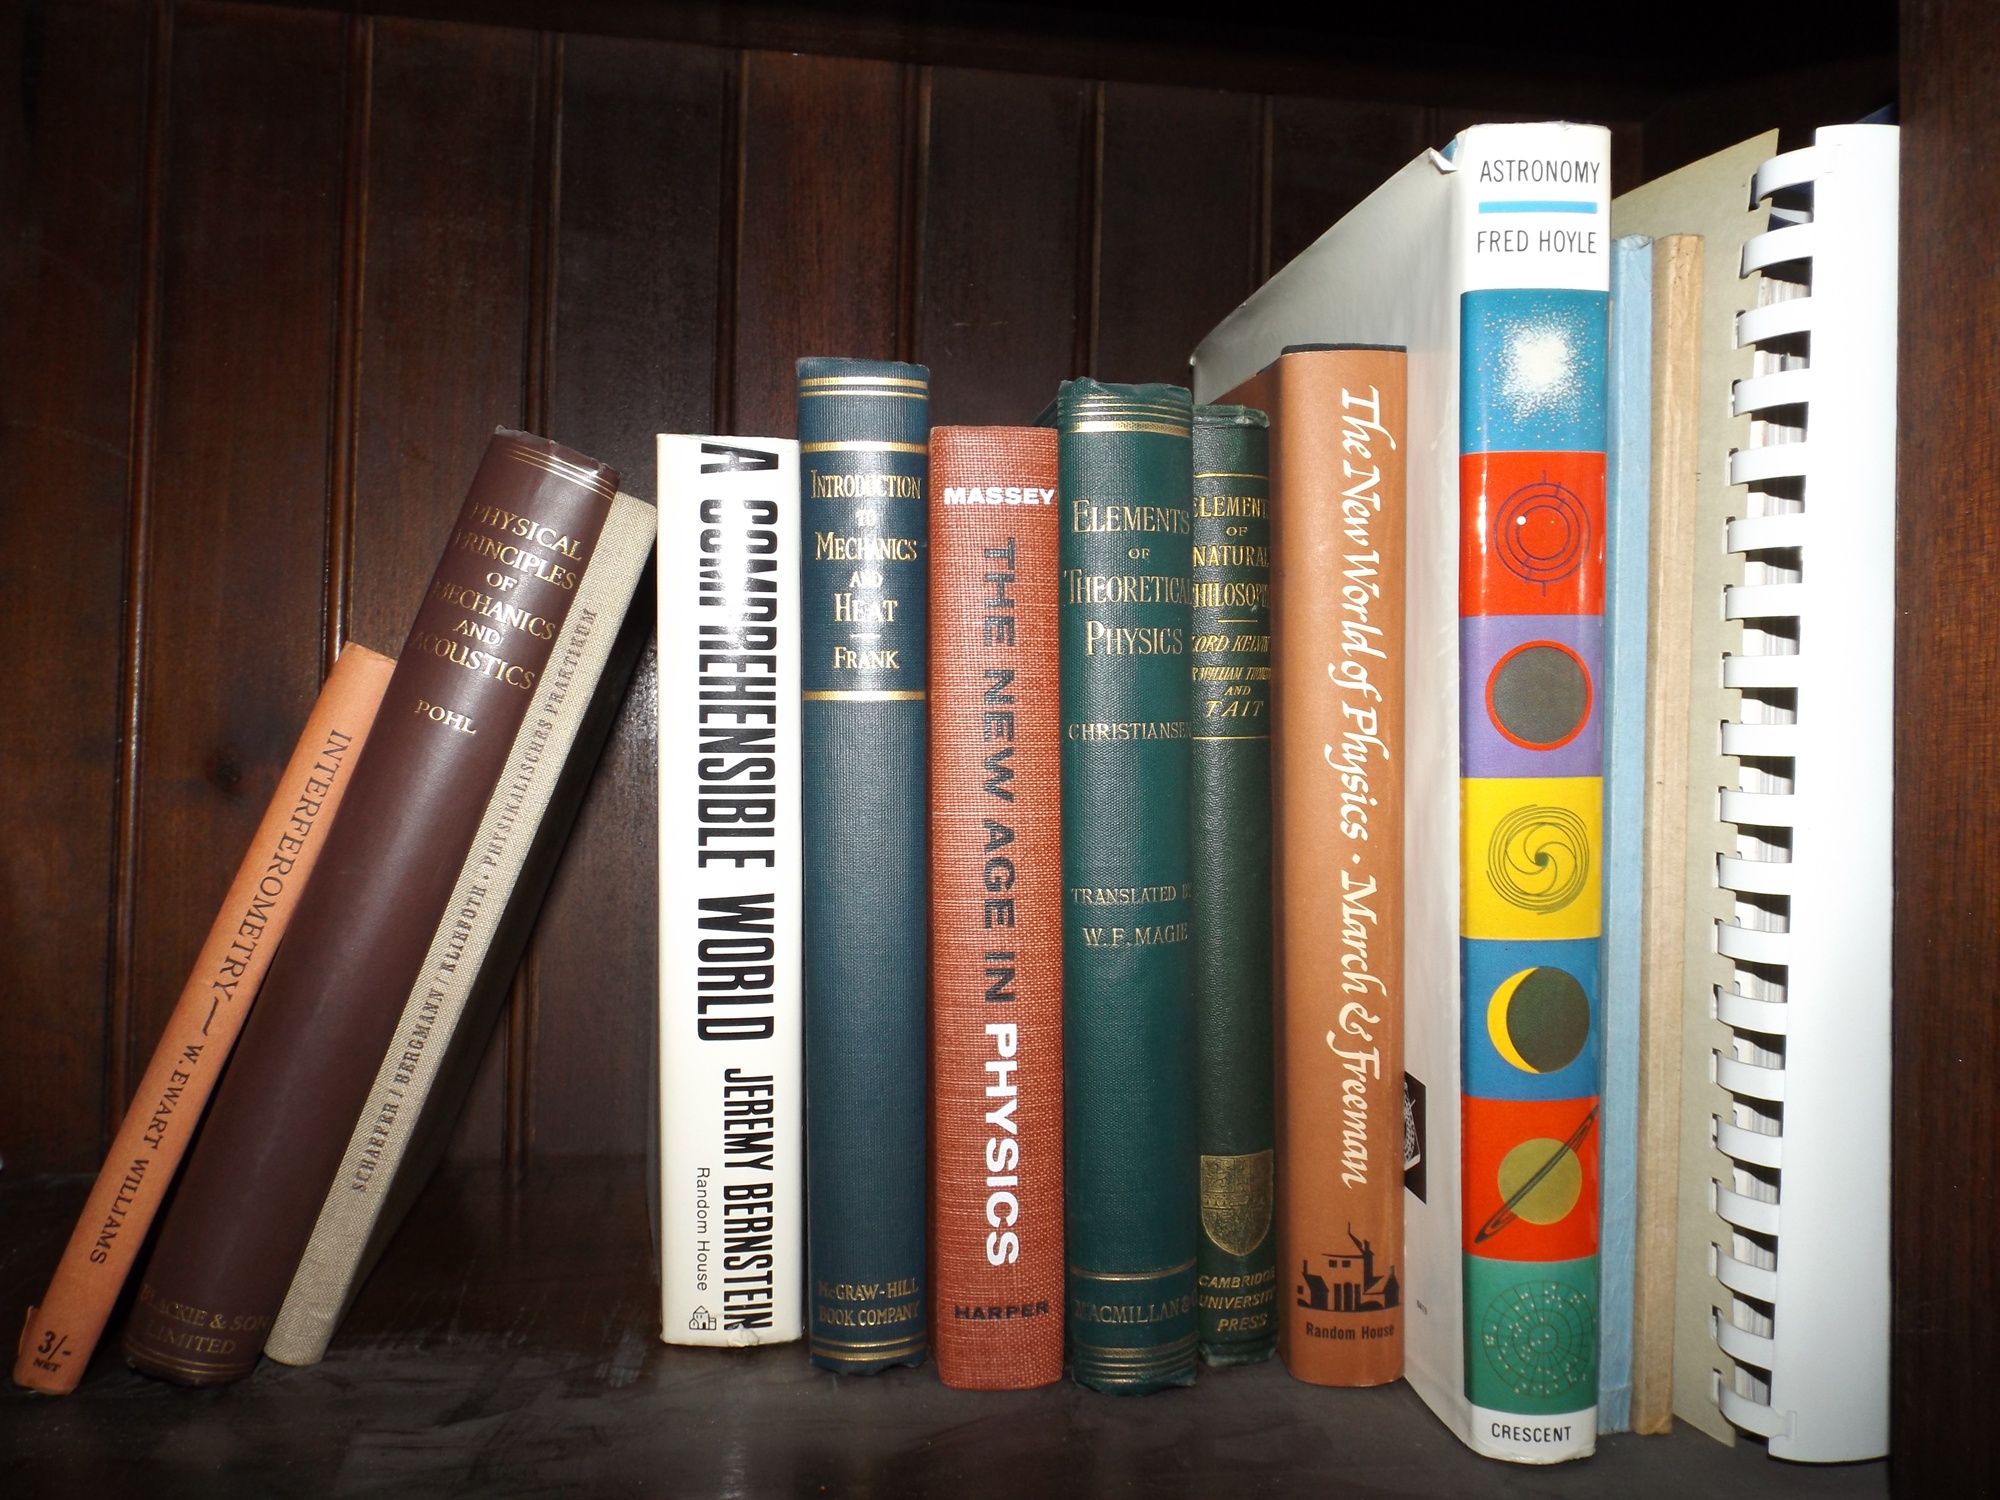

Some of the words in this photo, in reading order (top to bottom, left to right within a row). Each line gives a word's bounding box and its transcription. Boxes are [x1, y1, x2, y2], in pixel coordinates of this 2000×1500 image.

[1480, 159, 1600, 184] ASTRONOMY
[1477, 230, 1529, 253] FRED
[1539, 230, 1597, 254] HOYLE
[1341, 384, 1396, 459] The
[701, 442, 779, 474] A
[810, 470, 922, 499] INTRODUCTION
[943, 487, 1055, 505] MASSEY
[856, 509, 877, 527] TO
[1072, 499, 1190, 534] ELEMENTS
[1341, 459, 1381, 546] New
[469, 502, 583, 561] PHYSICAL
[815, 531, 917, 561] MECHANICS
[1226, 526, 1248, 536] OF
[1128, 548, 1151, 559] OF
[486, 572, 518, 592] OF
[849, 569, 883, 588] AND
[984, 537, 1015, 646] THE
[1063, 568, 1192, 604] THEORETICAL
[834, 593, 898, 622] HEAT
[1341, 550, 1388, 660] World
[453, 620, 501, 645] AND
[1085, 620, 1184, 656] PHYSICS
[833, 646, 900, 669] FRANK
[698, 499, 778, 868] COMPREHENSIBLE
[1224, 686, 1251, 696] AND
[1327, 660, 1382, 703] of
[414, 699, 477, 735] POHL
[1206, 700, 1264, 717] TAIT
[984, 670, 1015, 803] NEW
[1324, 700, 1389, 841] Physics
[212, 729, 352, 1002] INTERFEROMETRY
[984, 818, 1016, 929] AGE
[1071, 886, 1177, 904] TRANSLATED
[1135, 923, 1188, 946] MAGIE
[1341, 869, 1387, 995] March
[698, 893, 775, 1041] WORLD
[985, 952, 1016, 1003] IN
[394, 988, 445, 1084] BERGMANN
[1338, 1002, 1380, 1042] &
[178, 1043, 204, 1066] W.
[144, 1069, 190, 1150] EWART
[723, 1068, 774, 1171] JEREMY
[1326, 1029, 1380, 1189] Freeman
[985, 1023, 1020, 1266] PHYSICS
[90, 1159, 149, 1265] WILLIAMS
[696, 1167, 710, 1234] Random
[696, 1241, 710, 1291] House
[723, 1182, 774, 1331] BERNSTEIN
[1199, 1266, 1275, 1288] CAMBRIDGE
[209, 1313, 227, 1330] &
[819, 1305, 857, 1327] BOOK
[857, 1300, 920, 1327] COMPANY
[954, 1300, 1050, 1320] HARPER
[1217, 1313, 1268, 1332] PRESS
[1305, 1322, 1356, 1340] Random
[1361, 1325, 1395, 1340] House
[1491, 1422, 1572, 1443] CRESCENT
